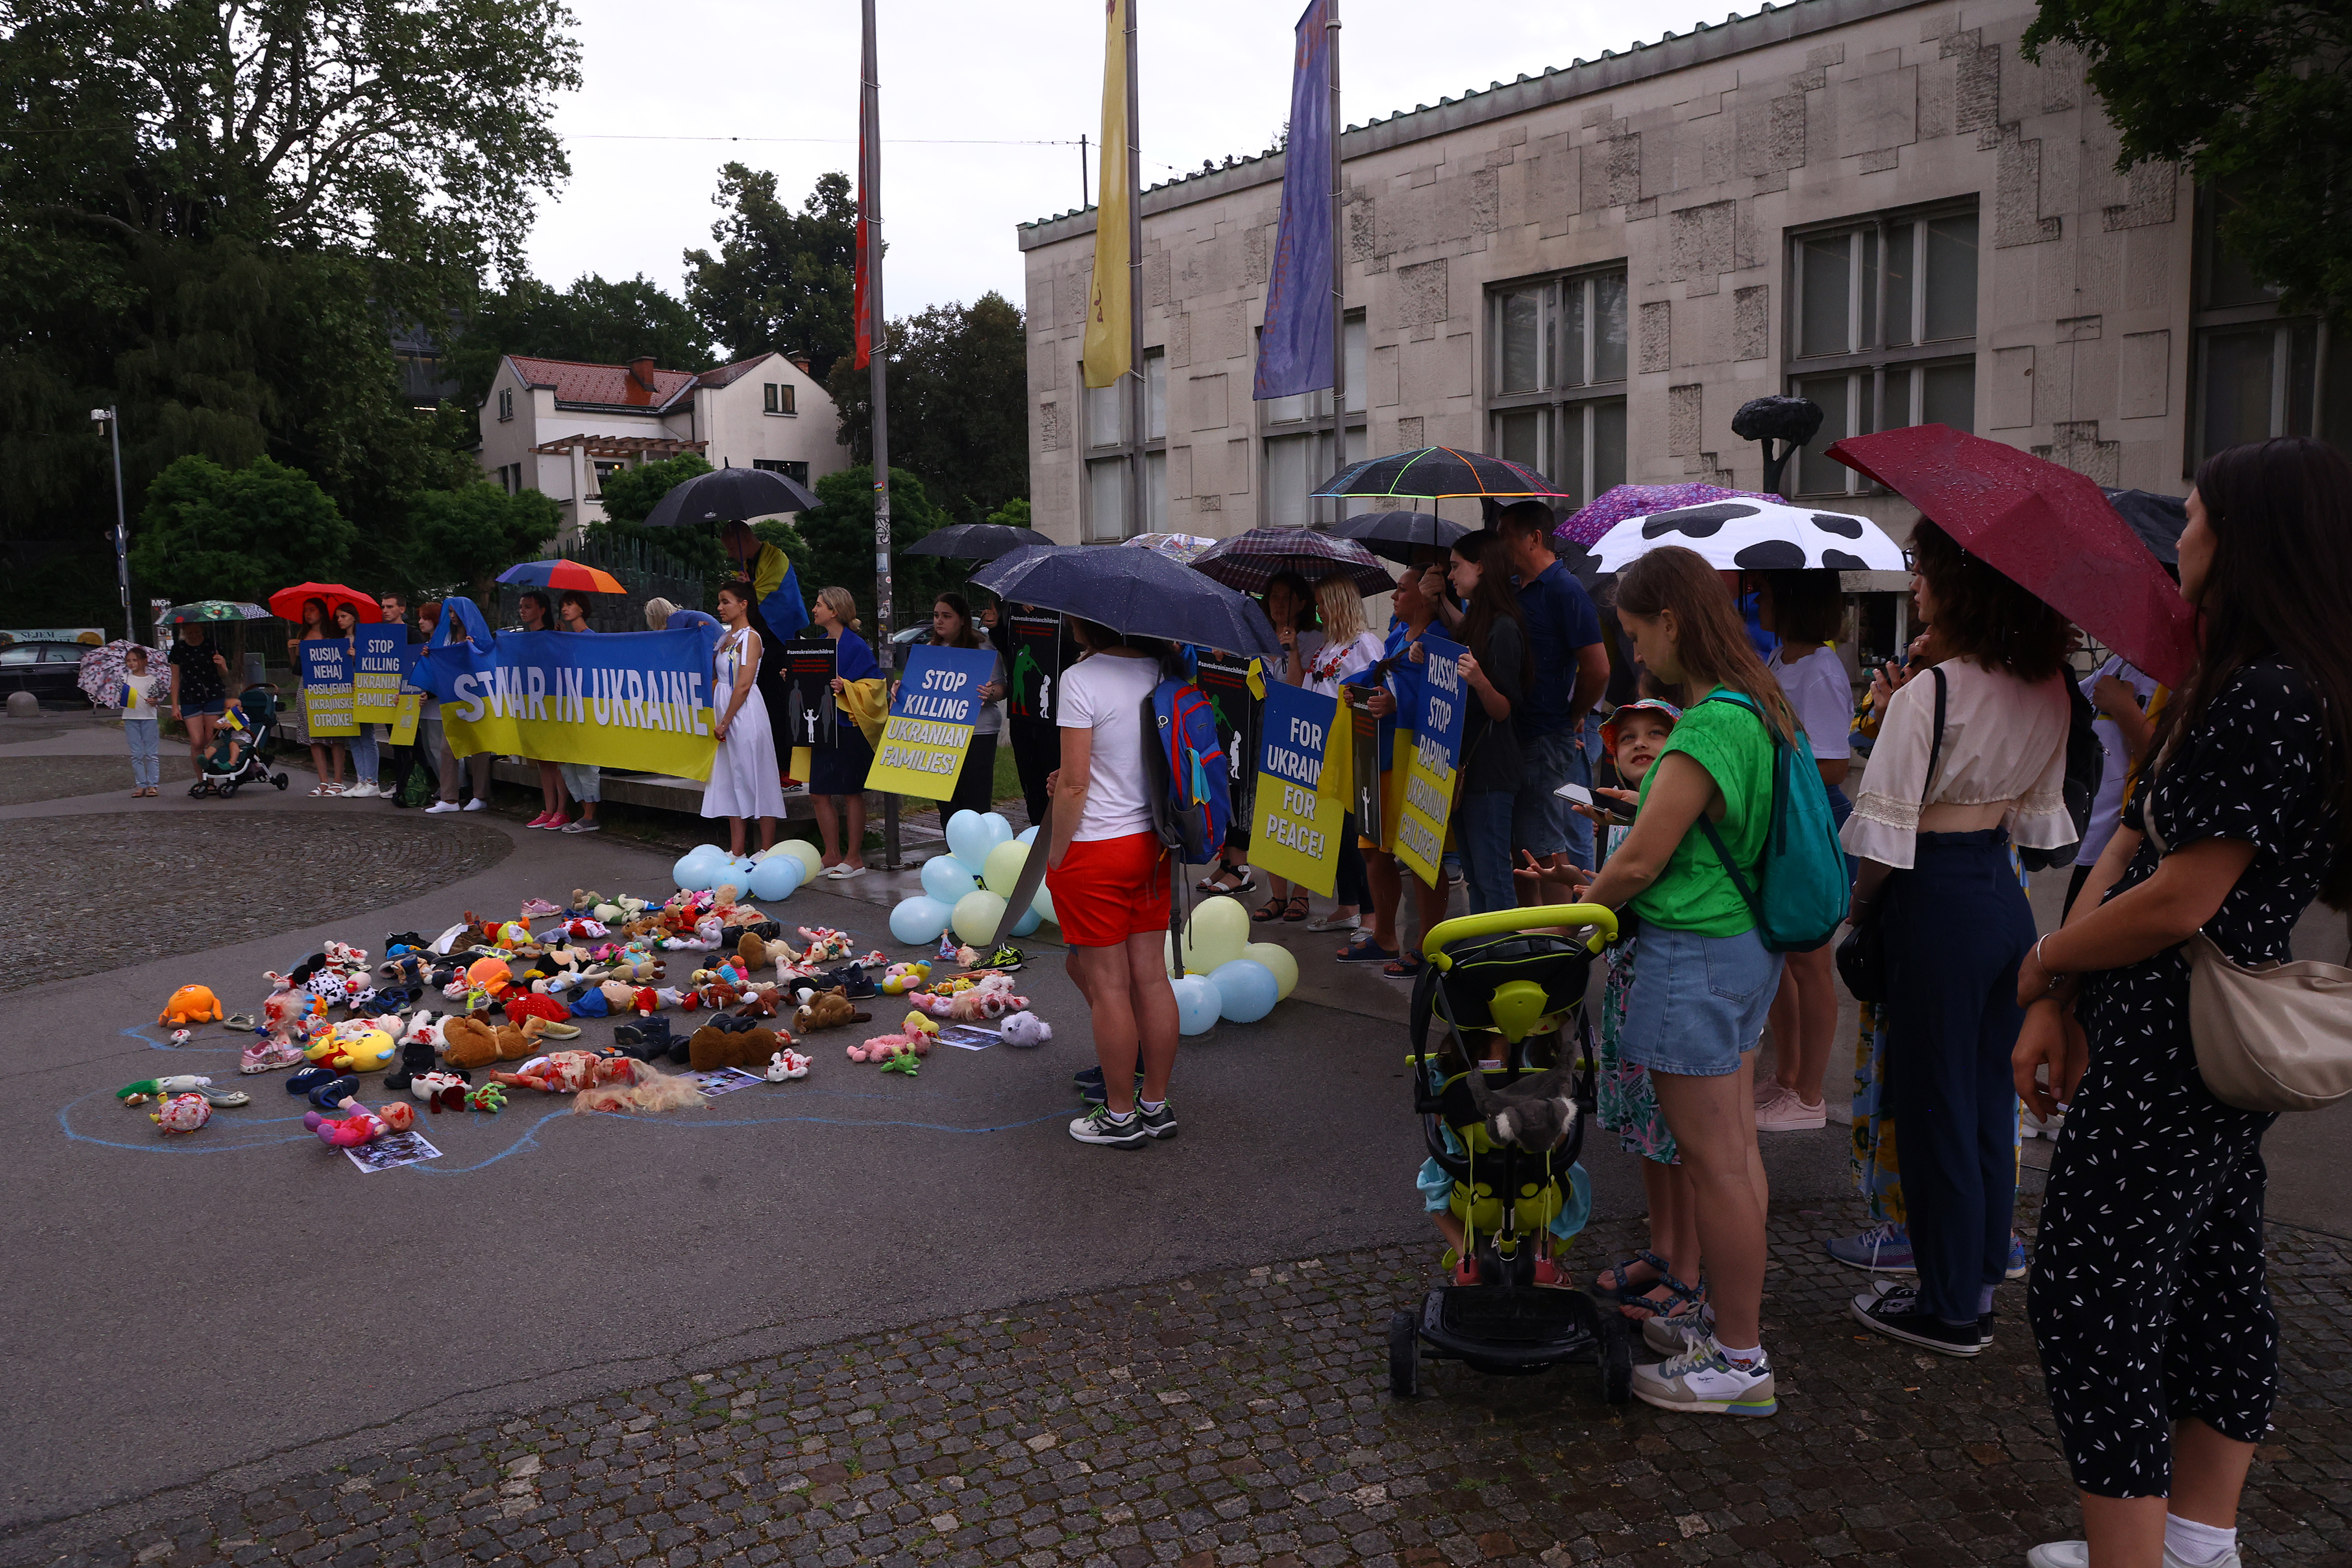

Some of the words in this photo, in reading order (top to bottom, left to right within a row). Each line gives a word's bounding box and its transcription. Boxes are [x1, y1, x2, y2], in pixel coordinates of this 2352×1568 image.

[1011, 615, 1059, 624] #saveukrainianchildren
[309, 647, 343, 662] RUSIJA,
[368, 640, 394, 653] STOP
[314, 665, 343, 680] NEHAJ
[362, 657, 399, 671] KILLING
[1428, 652, 1459, 701] RUSSIA,
[308, 683, 352, 696] POSILJEVATI
[357, 675, 401, 689] UKRANIAN
[922, 669, 967, 692] STOP
[309, 698, 354, 711] UKRAJINSKE
[556, 667, 584, 723] IN
[592, 668, 708, 736] UKRAINE
[902, 694, 969, 721] KILLING
[1428, 696, 1452, 734] STOP
[314, 713, 353, 727] OTROKE!
[887, 720, 969, 749] UKRANIAN
[1290, 717, 1322, 752] FOR
[879, 745, 958, 775] FAMILIES!
[1267, 744, 1324, 786] UKRAIN
[1417, 734, 1450, 781] RAPING
[1283, 785, 1316, 820] FOR
[1407, 773, 1449, 827] UKRANIAN
[1266, 813, 1325, 860] PEACE!
[1399, 812, 1441, 869] CHILDREN!
